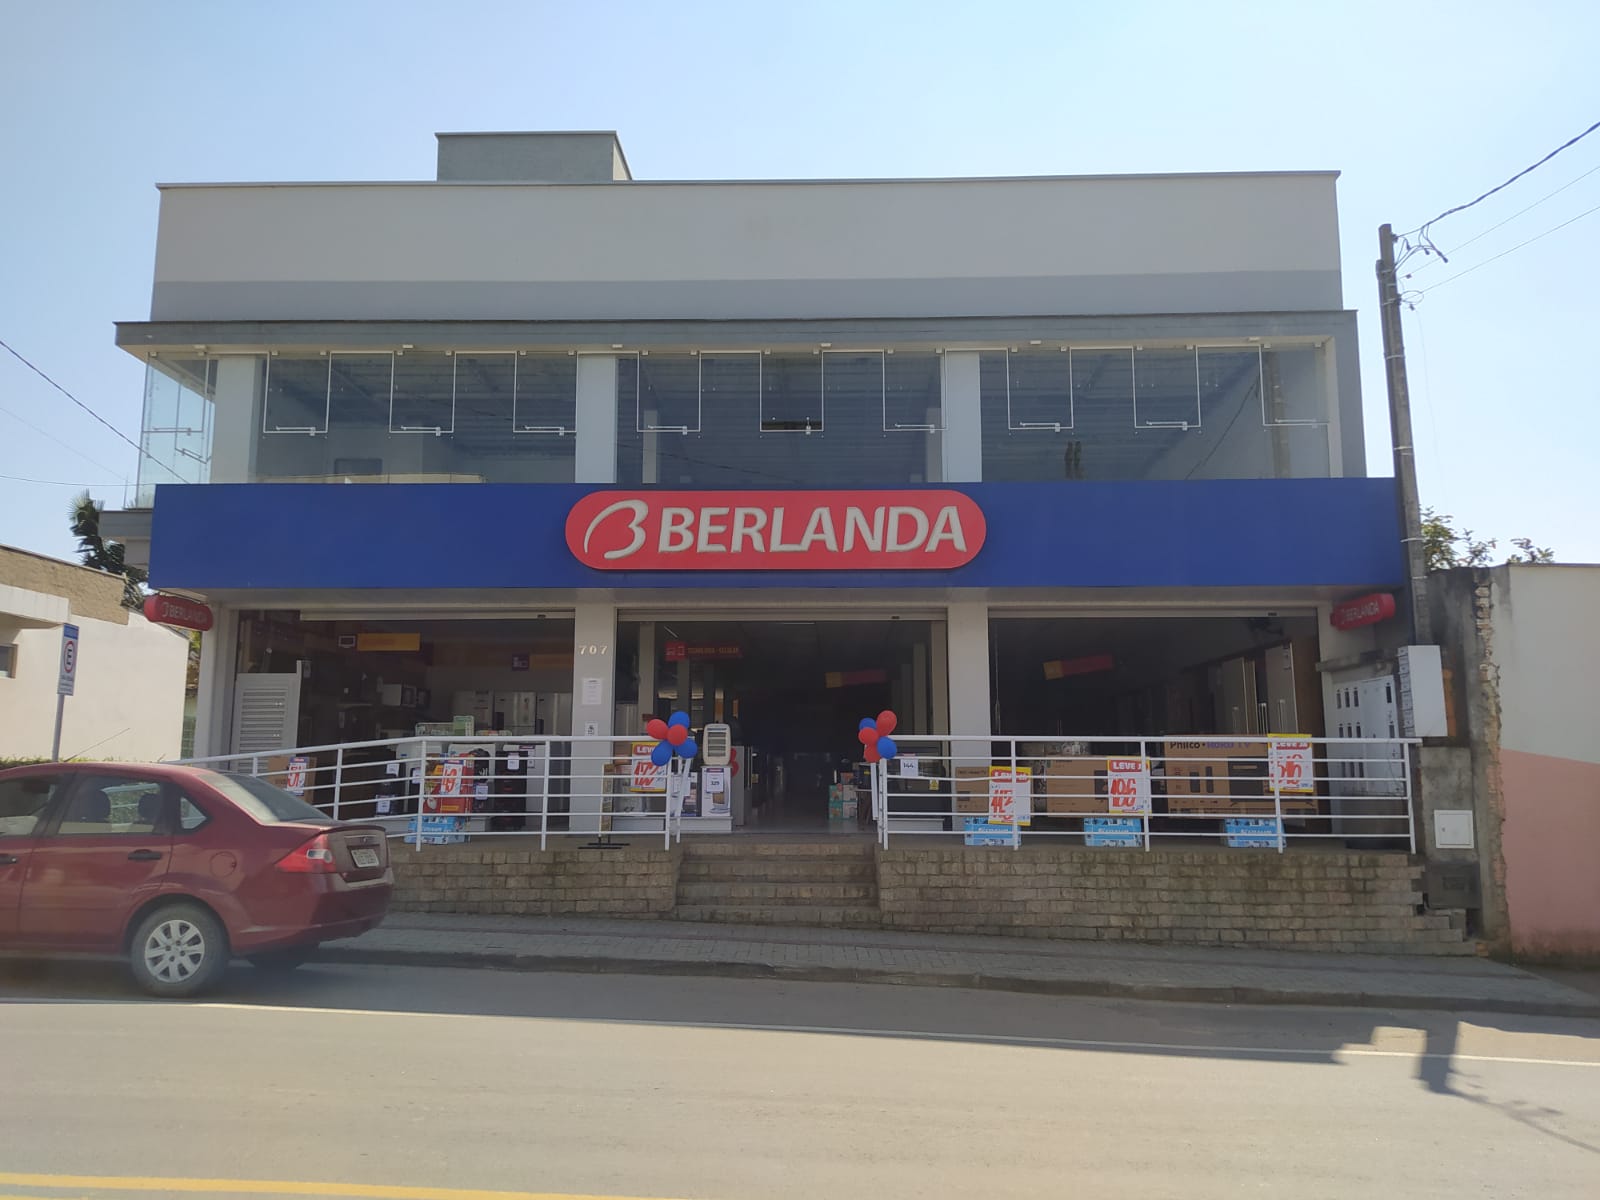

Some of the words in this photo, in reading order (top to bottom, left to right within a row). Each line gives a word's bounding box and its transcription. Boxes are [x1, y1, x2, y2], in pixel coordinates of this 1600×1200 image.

[658, 505, 968, 553] BERLANDA
[578, 645, 608, 656] 707
[1170, 741, 1201, 750] Philco
[1112, 761, 1136, 771] LEVE
